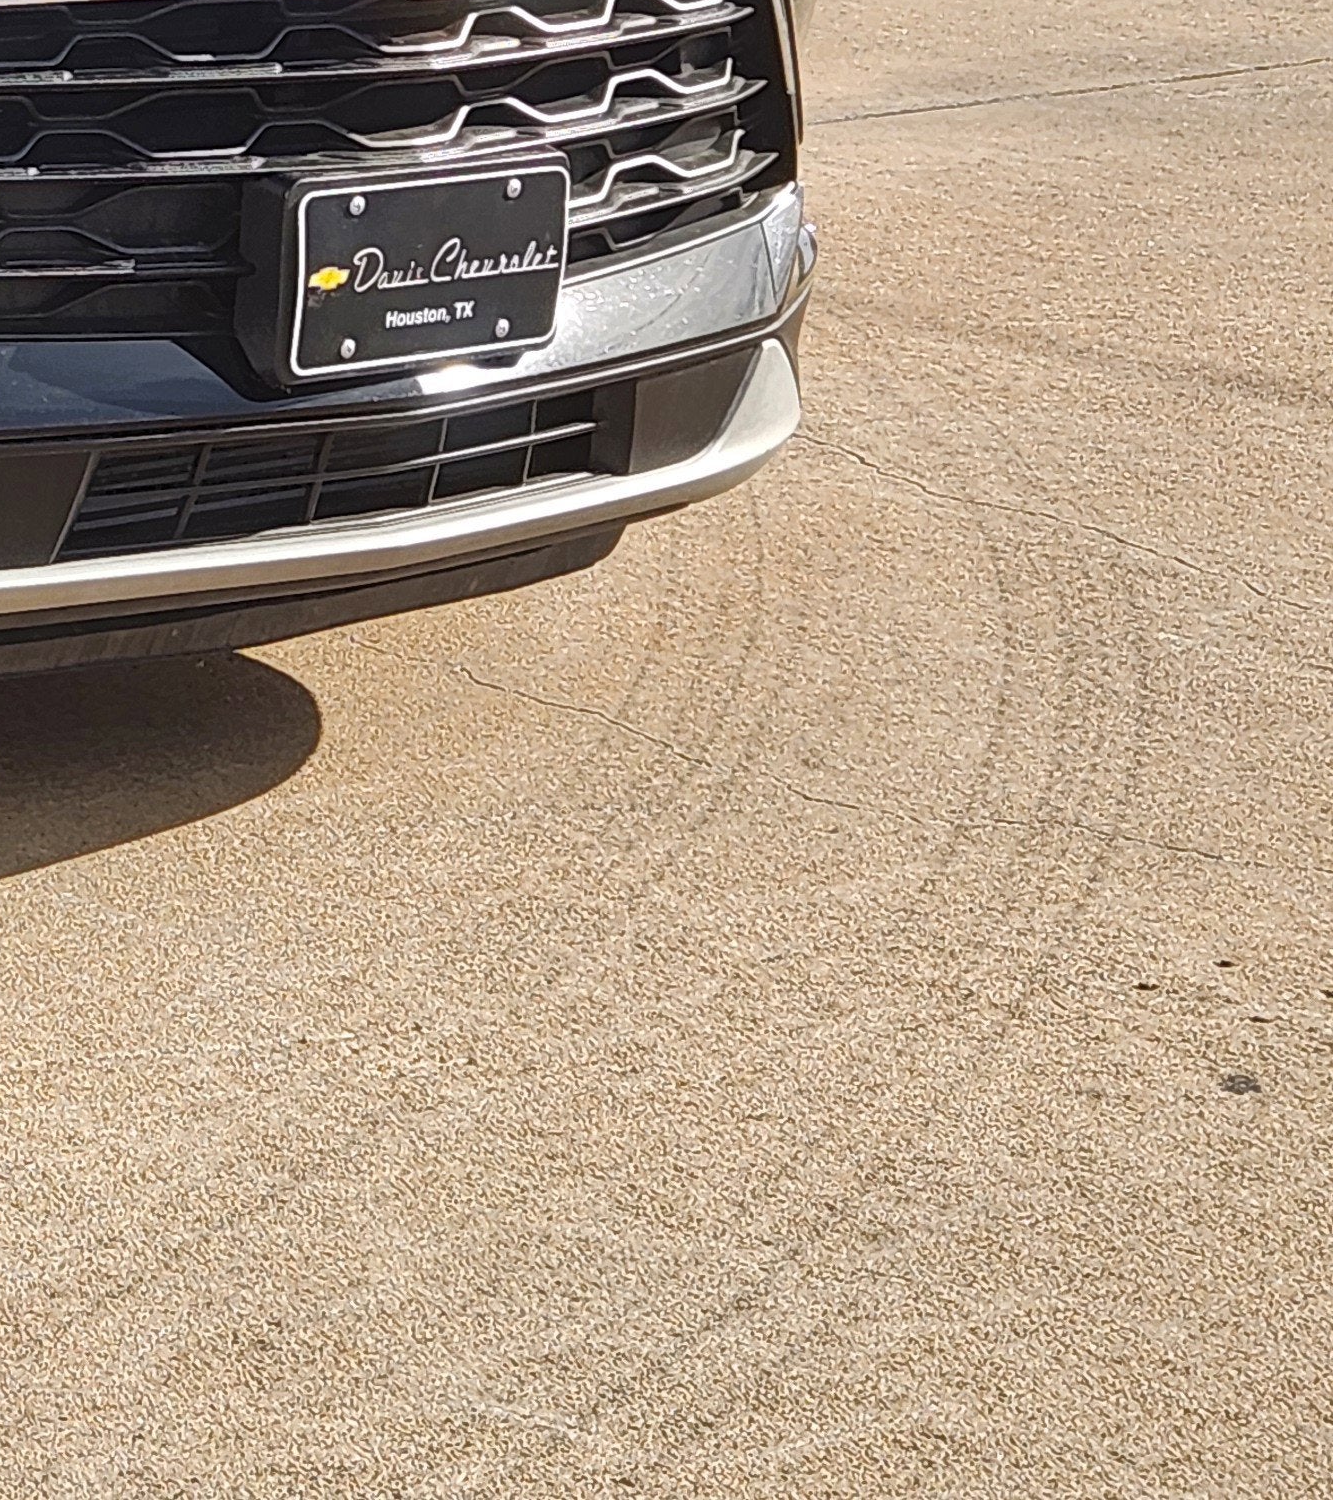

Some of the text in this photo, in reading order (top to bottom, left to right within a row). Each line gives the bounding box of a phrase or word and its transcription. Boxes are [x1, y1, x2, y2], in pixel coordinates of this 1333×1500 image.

[352, 237, 559, 293] Davis Chevrolet
[385, 300, 475, 329] Houston, TX
